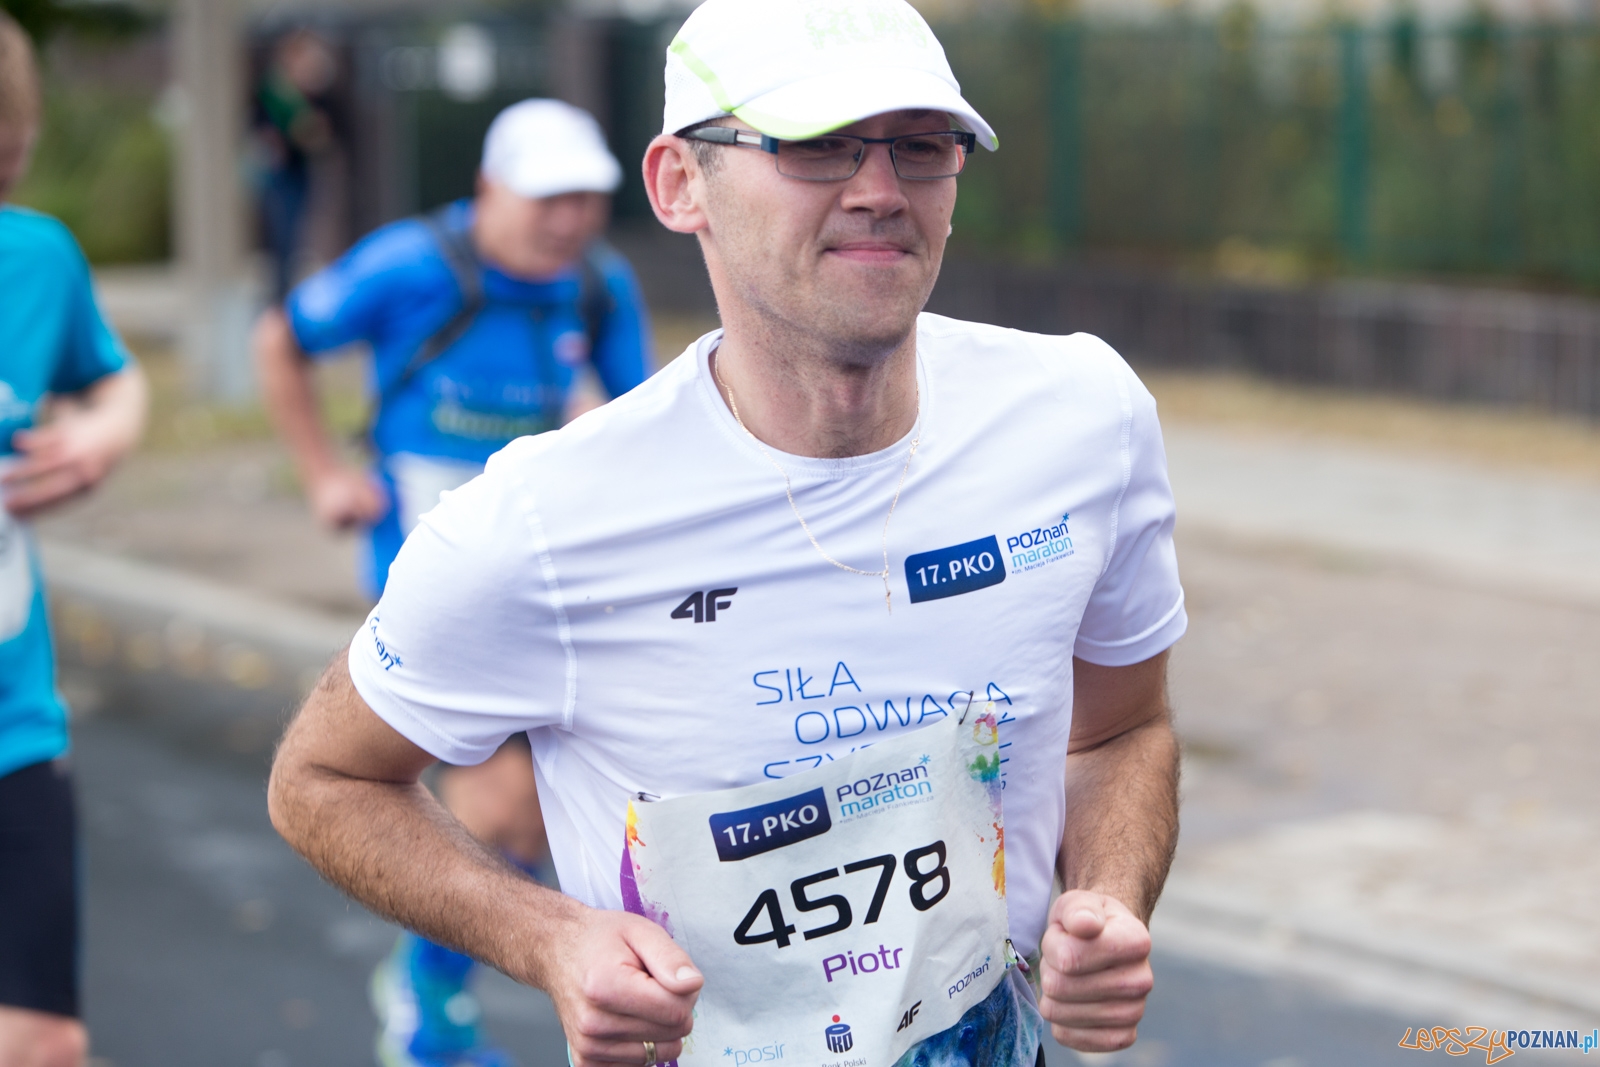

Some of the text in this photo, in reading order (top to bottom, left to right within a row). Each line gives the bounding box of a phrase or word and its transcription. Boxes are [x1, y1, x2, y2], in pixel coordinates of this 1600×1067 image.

[1012, 537, 1073, 567] maraton
[670, 587, 738, 623] 4F
[753, 661, 861, 706] SIŁA
[841, 781, 932, 817] maraton
[733, 840, 951, 949] 4578
[822, 944, 903, 983] Piotr
